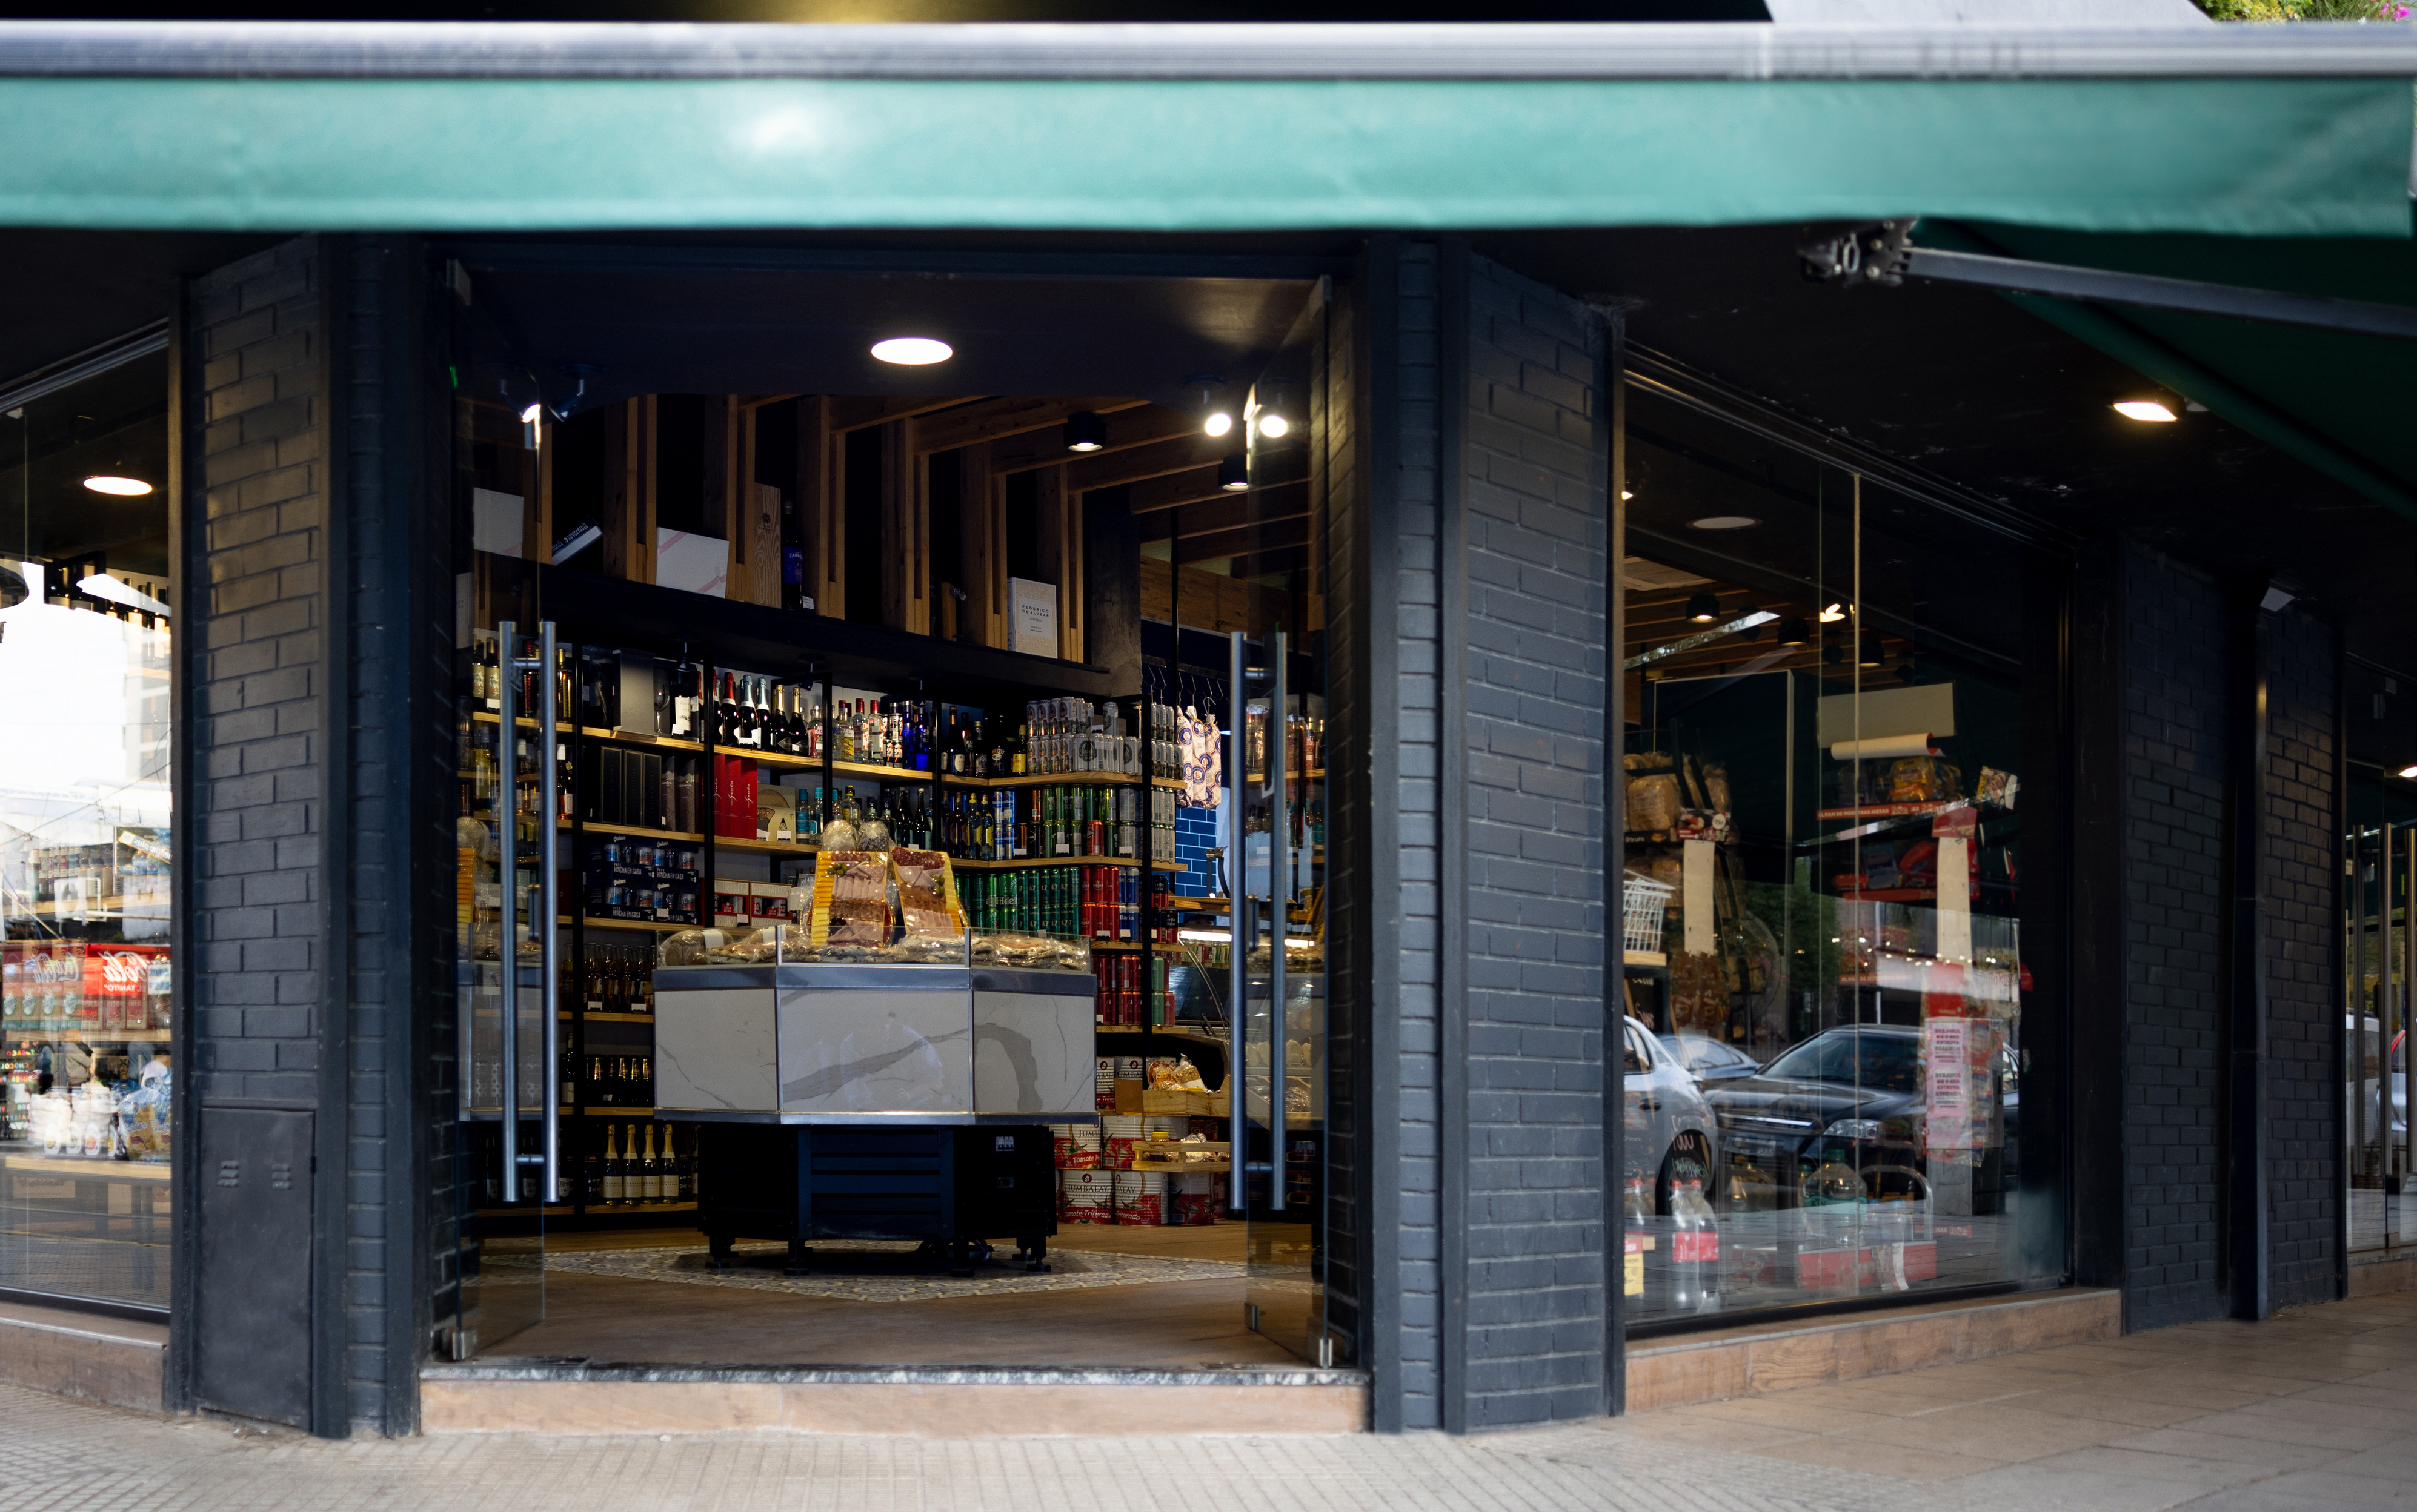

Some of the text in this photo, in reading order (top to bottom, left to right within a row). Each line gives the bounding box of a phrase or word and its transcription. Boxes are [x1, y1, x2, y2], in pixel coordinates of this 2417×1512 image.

[1022, 605, 1049, 613] FEDERICO
[1068, 1184, 1108, 1193] JUMBALAY
[1084, 1209, 1111, 1219] Triturado
